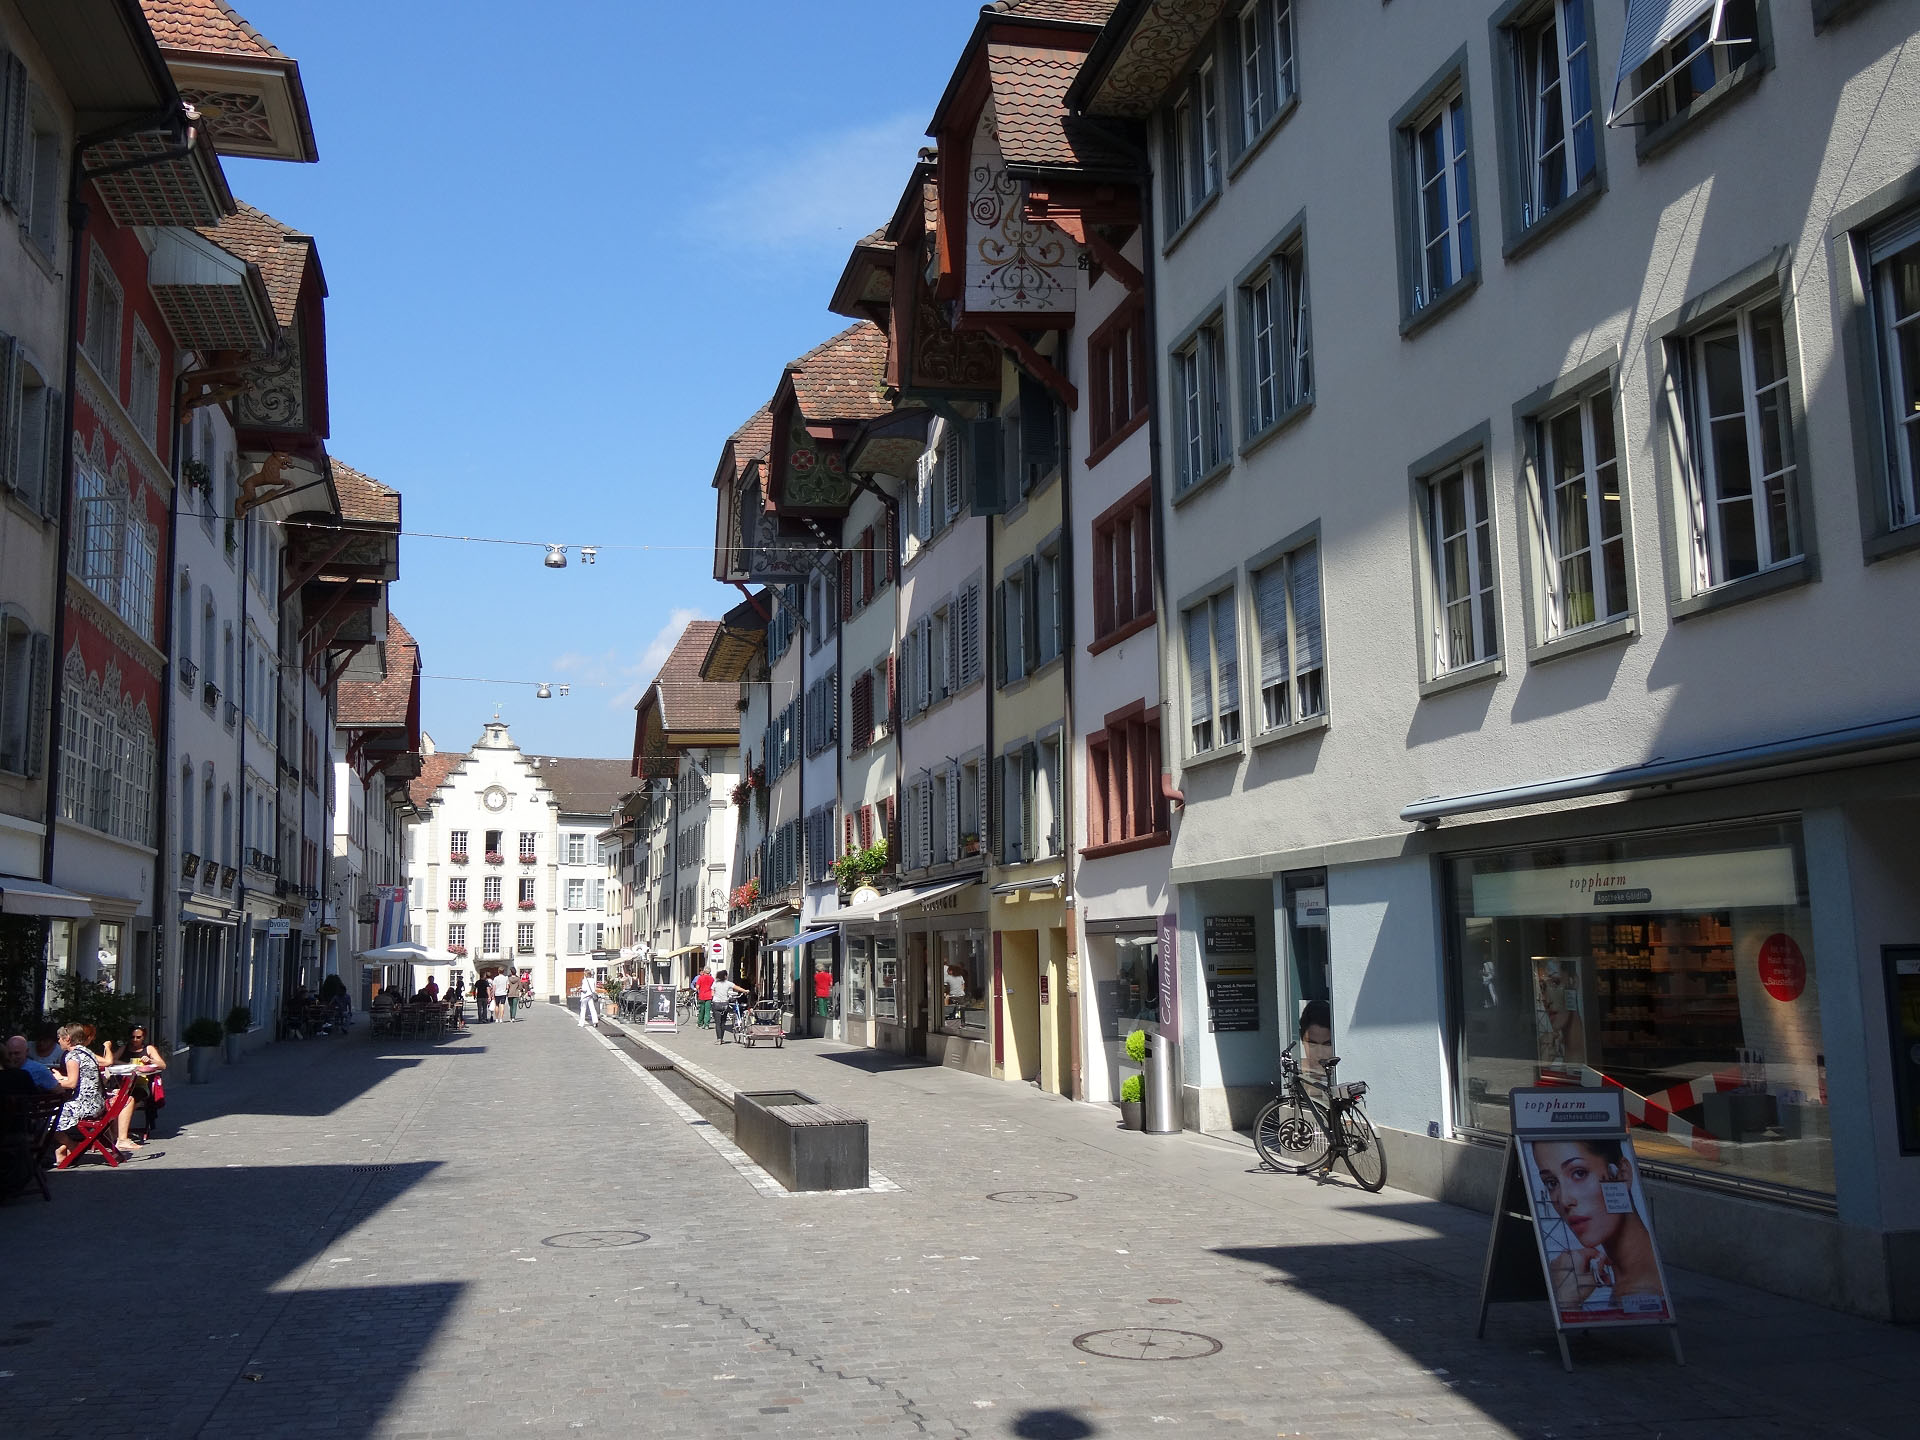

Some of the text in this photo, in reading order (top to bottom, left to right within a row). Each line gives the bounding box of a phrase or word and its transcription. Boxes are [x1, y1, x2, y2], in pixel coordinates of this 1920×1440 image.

[1569, 872, 1626, 893] toppharm
[1597, 893, 1625, 904] Apotheke
[1160, 927, 1171, 1025] Callamola
[1525, 1098, 1586, 1113] toppharm
